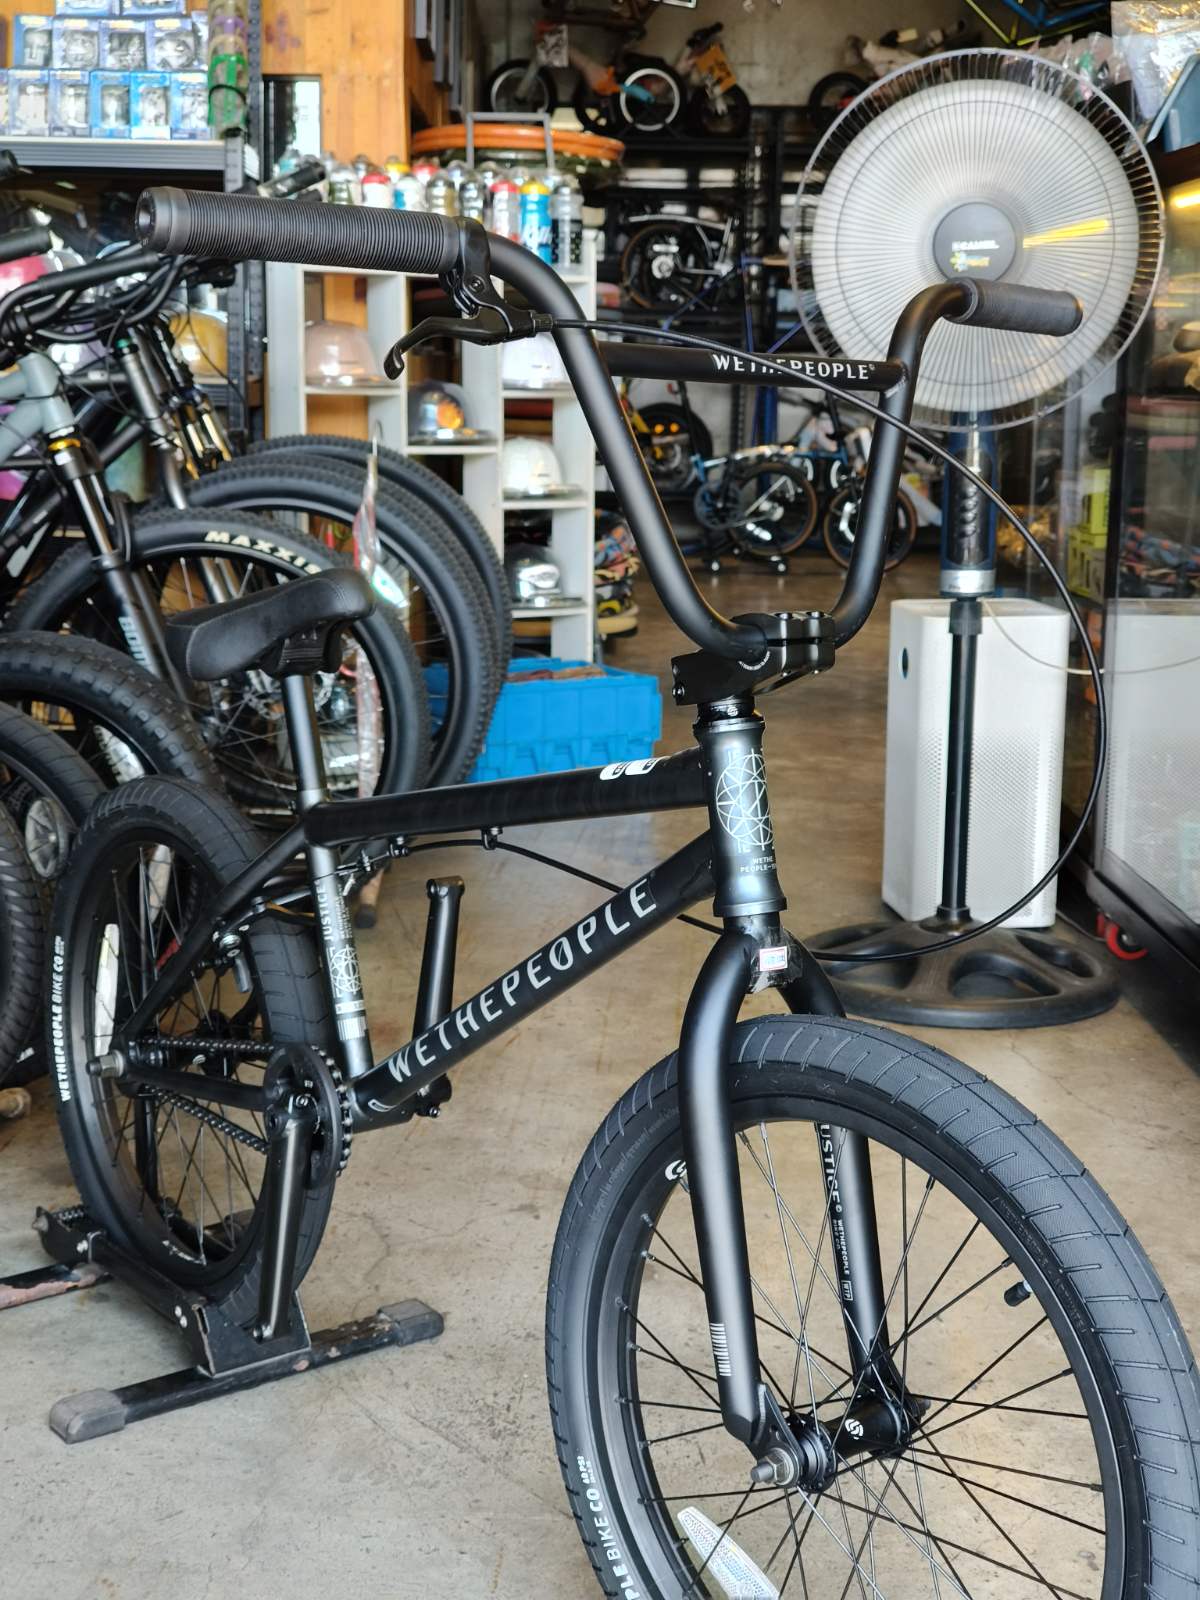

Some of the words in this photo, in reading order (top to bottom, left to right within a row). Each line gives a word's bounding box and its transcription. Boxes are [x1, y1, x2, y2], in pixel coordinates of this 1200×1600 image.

[712, 354, 869, 380] WEPEOPLE
[204, 530, 322, 575] MAXXIS
[51, 972, 64, 1004] BIKE
[388, 878, 657, 1082] WETHEPEOPLE
[586, 1488, 604, 1512] CO
[594, 1516, 621, 1560] BIKE
